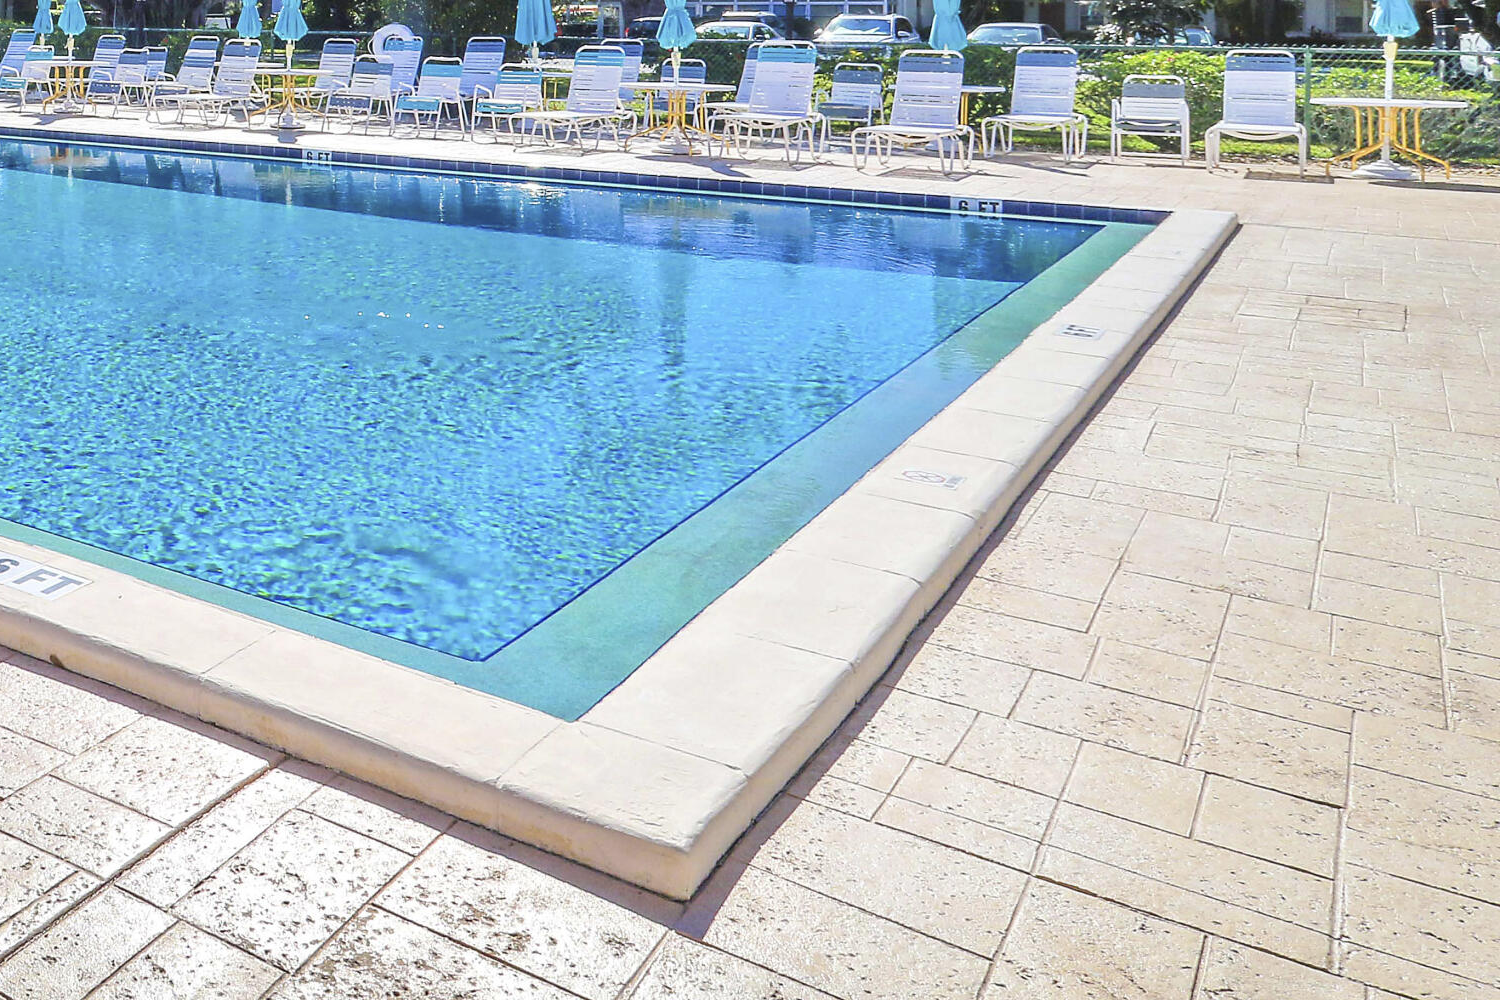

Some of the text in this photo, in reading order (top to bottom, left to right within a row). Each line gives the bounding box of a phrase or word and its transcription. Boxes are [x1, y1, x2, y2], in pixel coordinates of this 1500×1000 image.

[317, 152, 330, 162] FT
[958, 200, 1000, 214] 6 FT
[11, 568, 84, 595] FT
